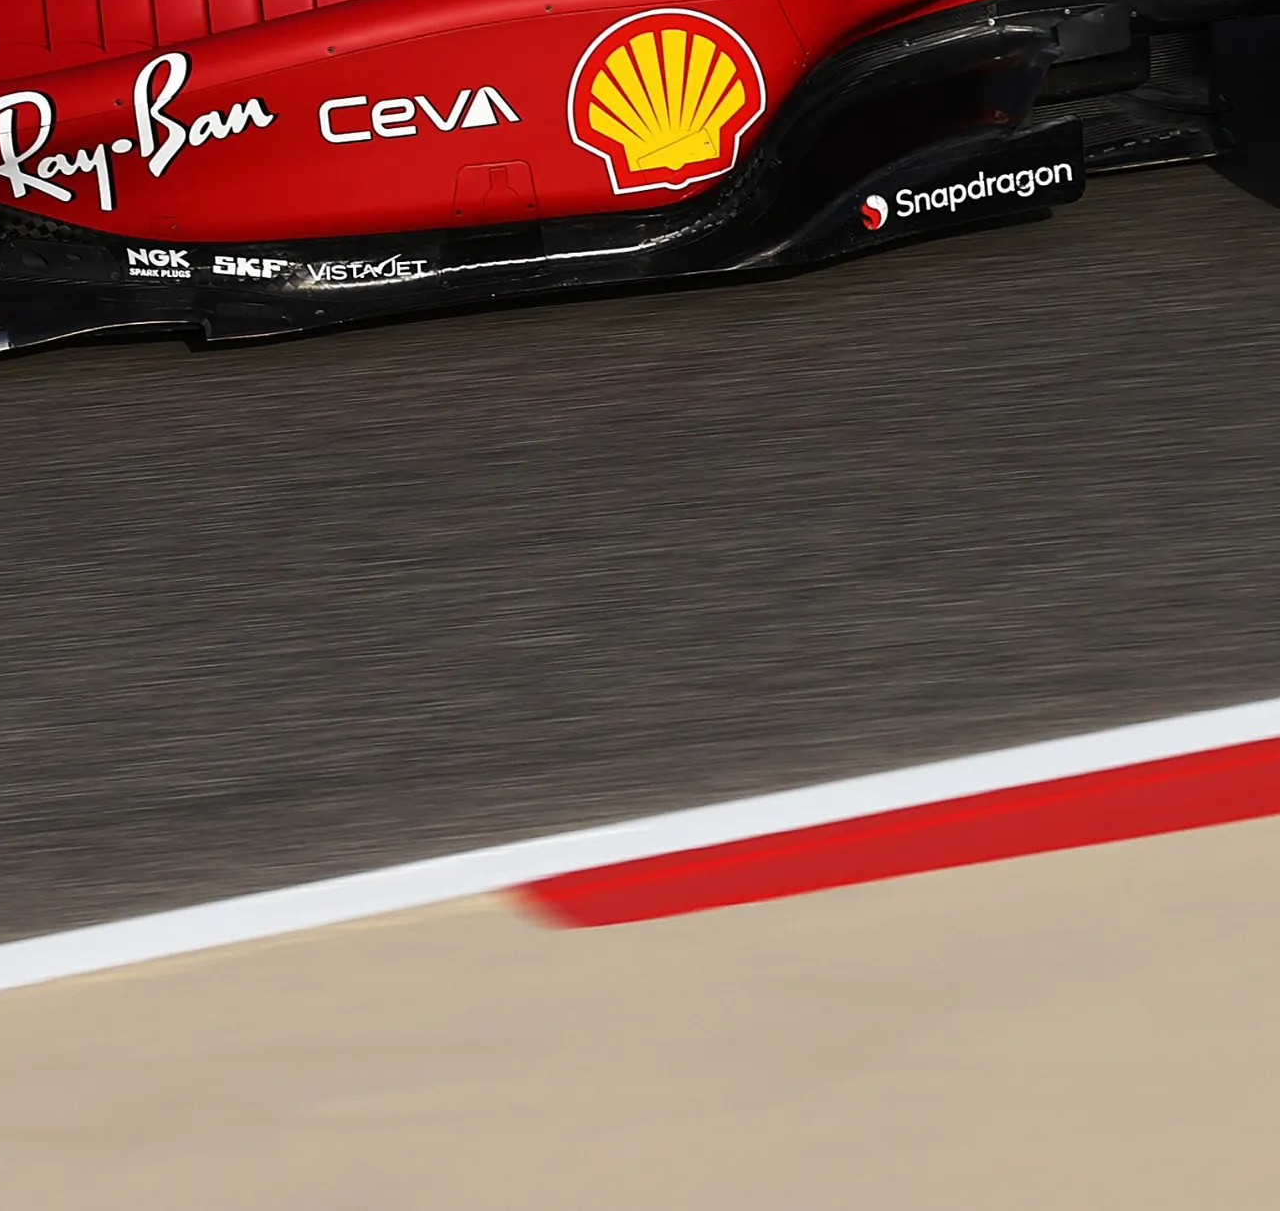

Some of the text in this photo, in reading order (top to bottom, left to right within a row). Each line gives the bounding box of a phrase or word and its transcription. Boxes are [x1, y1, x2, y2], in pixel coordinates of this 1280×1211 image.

[895, 163, 1073, 217] Snapdragon
[126, 247, 191, 268] NGK
[213, 255, 288, 279] SKF
[129, 267, 191, 279] SPARK PLUGS
